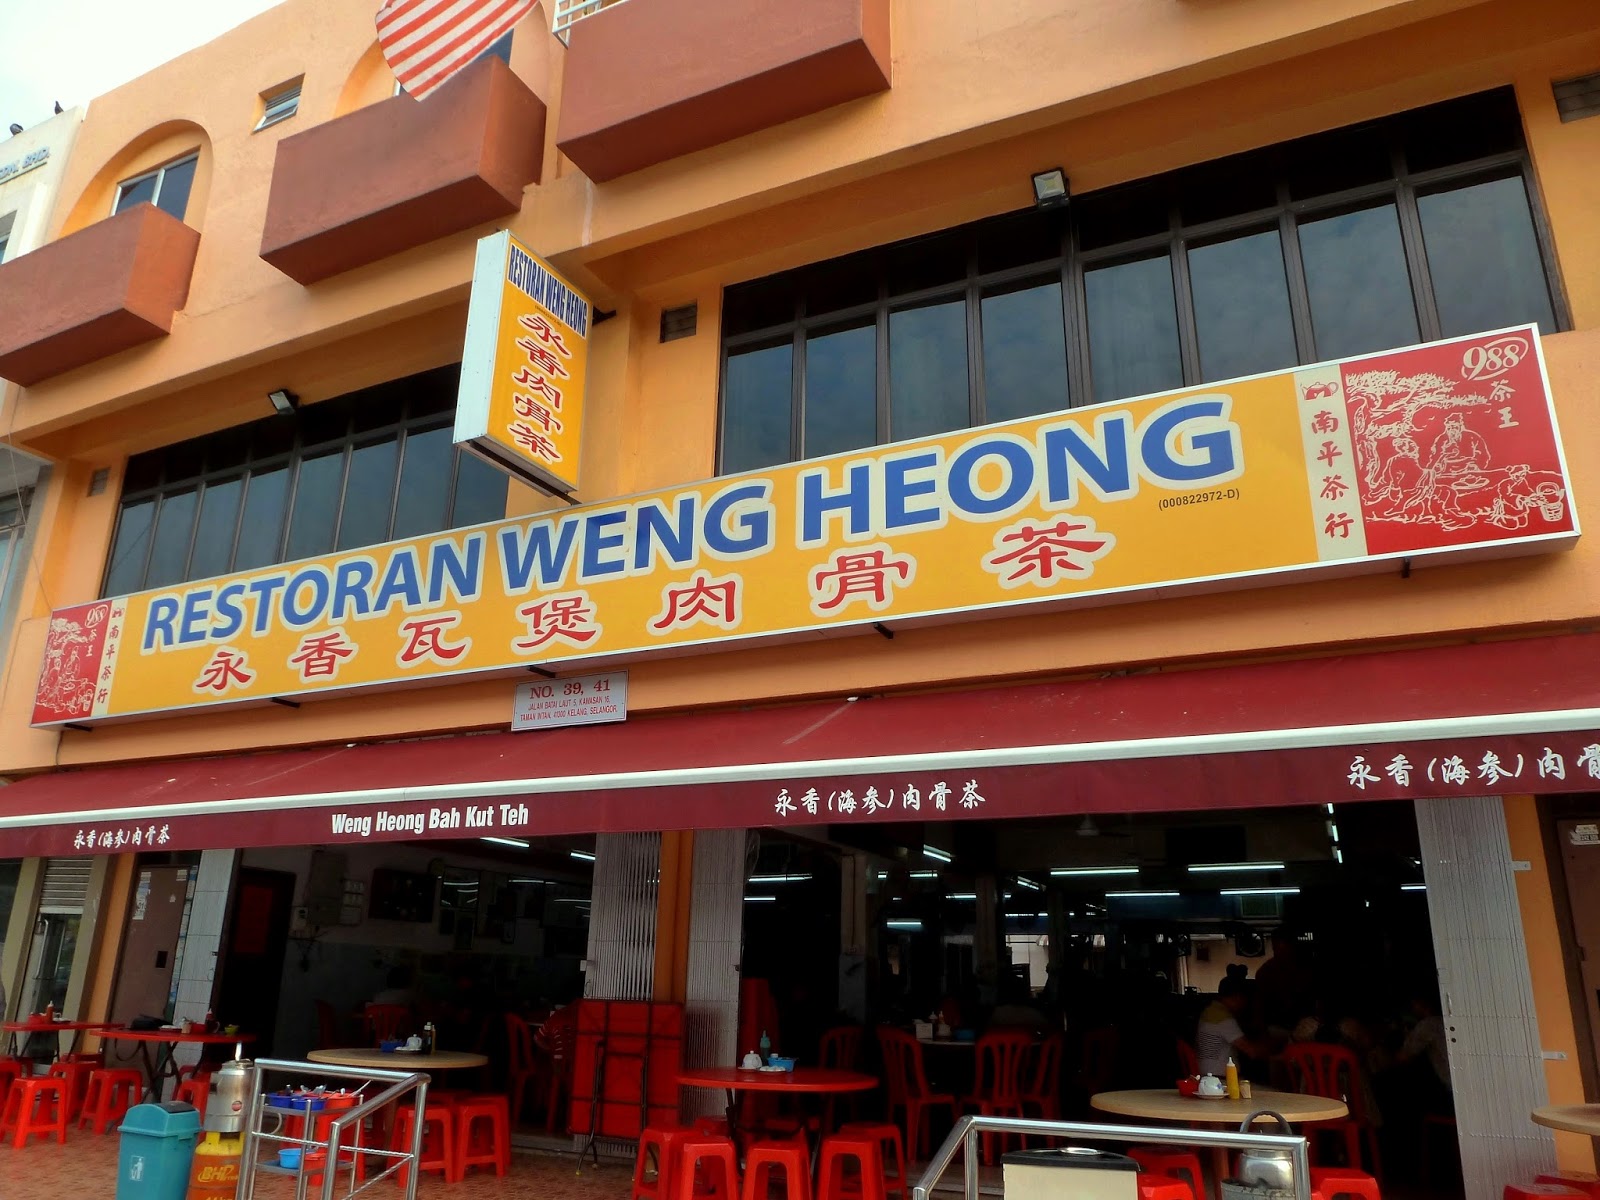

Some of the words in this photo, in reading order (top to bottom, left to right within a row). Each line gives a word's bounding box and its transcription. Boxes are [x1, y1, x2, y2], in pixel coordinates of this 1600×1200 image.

[508, 244, 547, 306] RESTORAN
[545, 272, 566, 321] WENG
[565, 289, 588, 338] HEONG
[1461, 340, 1521, 381] 988
[509, 315, 571, 461] 永香肉骨茶
[1489, 379, 1520, 430] 茶王
[1311, 410, 1355, 539] 南平茶行
[1158, 488, 1240, 512] (000822972-D)
[143, 537, 482, 650] RESTORAN
[500, 485, 770, 590] WENG
[802, 401, 1236, 542] HEONG
[195, 521, 1108, 692] 永香瓦煲肉骨茶
[528, 702, 544, 711] JALAN
[559, 699, 571, 708] LAUT
[579, 696, 602, 705] KAWASAN
[529, 686, 555, 700] NO.
[563, 682, 584, 696] 39,
[593, 678, 611, 692] 41
[520, 713, 536, 721] TAMAN
[331, 813, 372, 837] Weng
[375, 811, 425, 834] Heong
[428, 808, 460, 829] Bah
[465, 806, 494, 828] Kut
[499, 803, 529, 826] Teh
